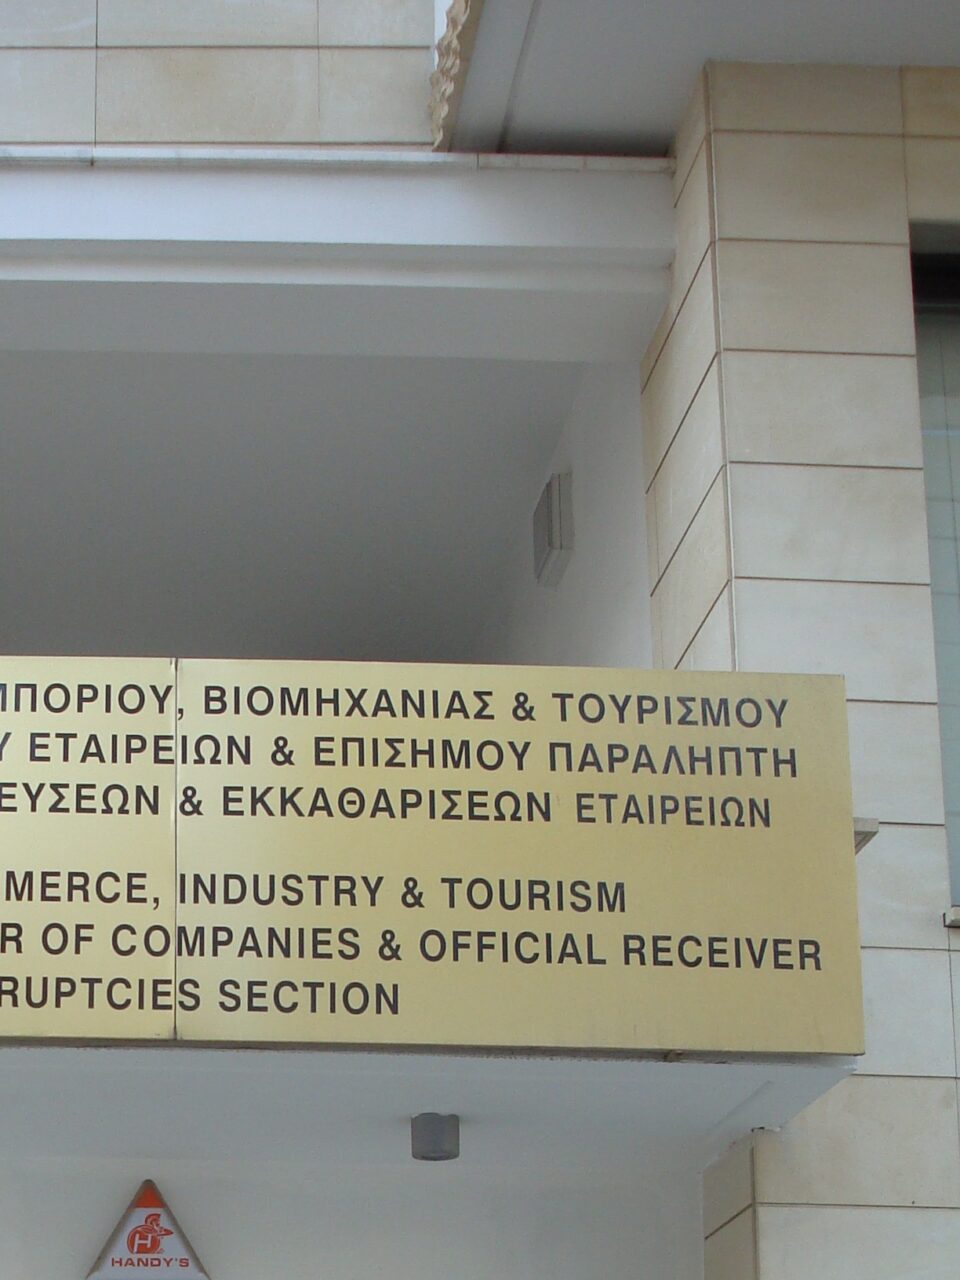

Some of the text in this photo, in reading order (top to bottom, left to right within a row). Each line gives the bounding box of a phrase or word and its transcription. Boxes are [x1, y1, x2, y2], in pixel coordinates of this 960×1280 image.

[203, 685, 496, 721] ΒΙΟΜΗΧΑΝΙΑΣ
[511, 691, 537, 722] &
[551, 692, 788, 729] ΤΟΥΡΙΣΜΟΥ
[29, 731, 252, 766] ΕΤΑΙΡΕΙΩΝ
[270, 735, 296, 767] &
[313, 736, 532, 772] ΕΠΙΣΗΜΟΥ
[548, 741, 797, 778] ΠΑΡΑΛΗΠΤΗ
[178, 785, 204, 817] &
[222, 785, 551, 823] ΕΚΚΑΘΑΡΙΣΕΩΝ
[575, 792, 771, 828] ΕΤΑΙΡΕΙΩΝ
[179, 872, 384, 908] INDUSTRY
[400, 876, 426, 909] &
[440, 877, 626, 913] TOURISM
[41, 922, 95, 956] OF
[111, 923, 361, 961] COMPANIES
[378, 929, 402, 962] &
[419, 928, 607, 966] OFFICIAL
[622, 934, 822, 971] RECEIVER
[218, 978, 399, 1016] SECTION
[111, 1257, 189, 1268] HANDY'S
